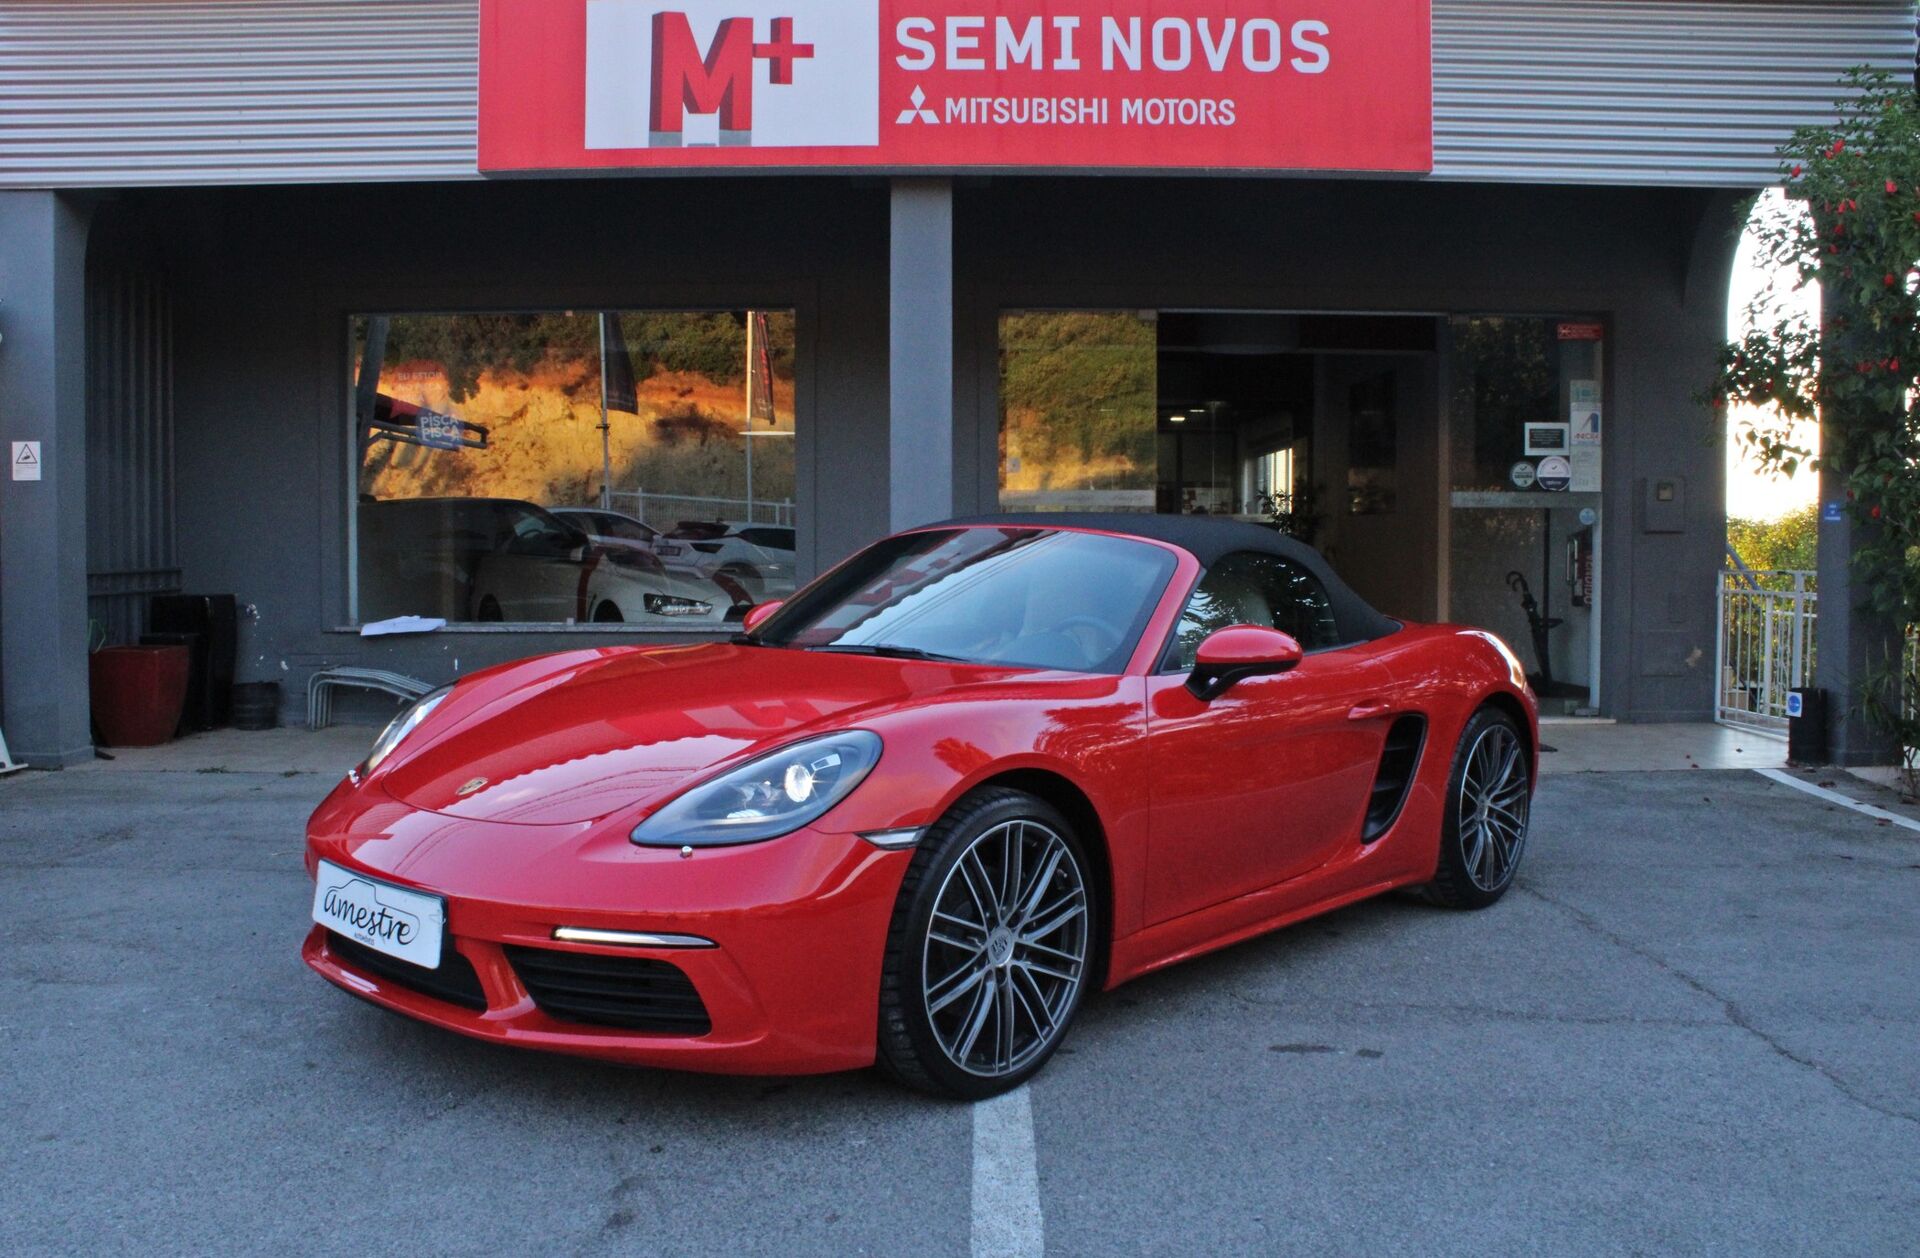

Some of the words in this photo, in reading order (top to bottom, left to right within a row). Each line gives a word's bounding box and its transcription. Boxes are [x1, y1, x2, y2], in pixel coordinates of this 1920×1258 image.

[895, 16, 1081, 71] SEMI
[1101, 16, 1331, 74] NOVOS
[945, 97, 1108, 125] MITSUBISHI
[1121, 98, 1237, 126] MOTORS
